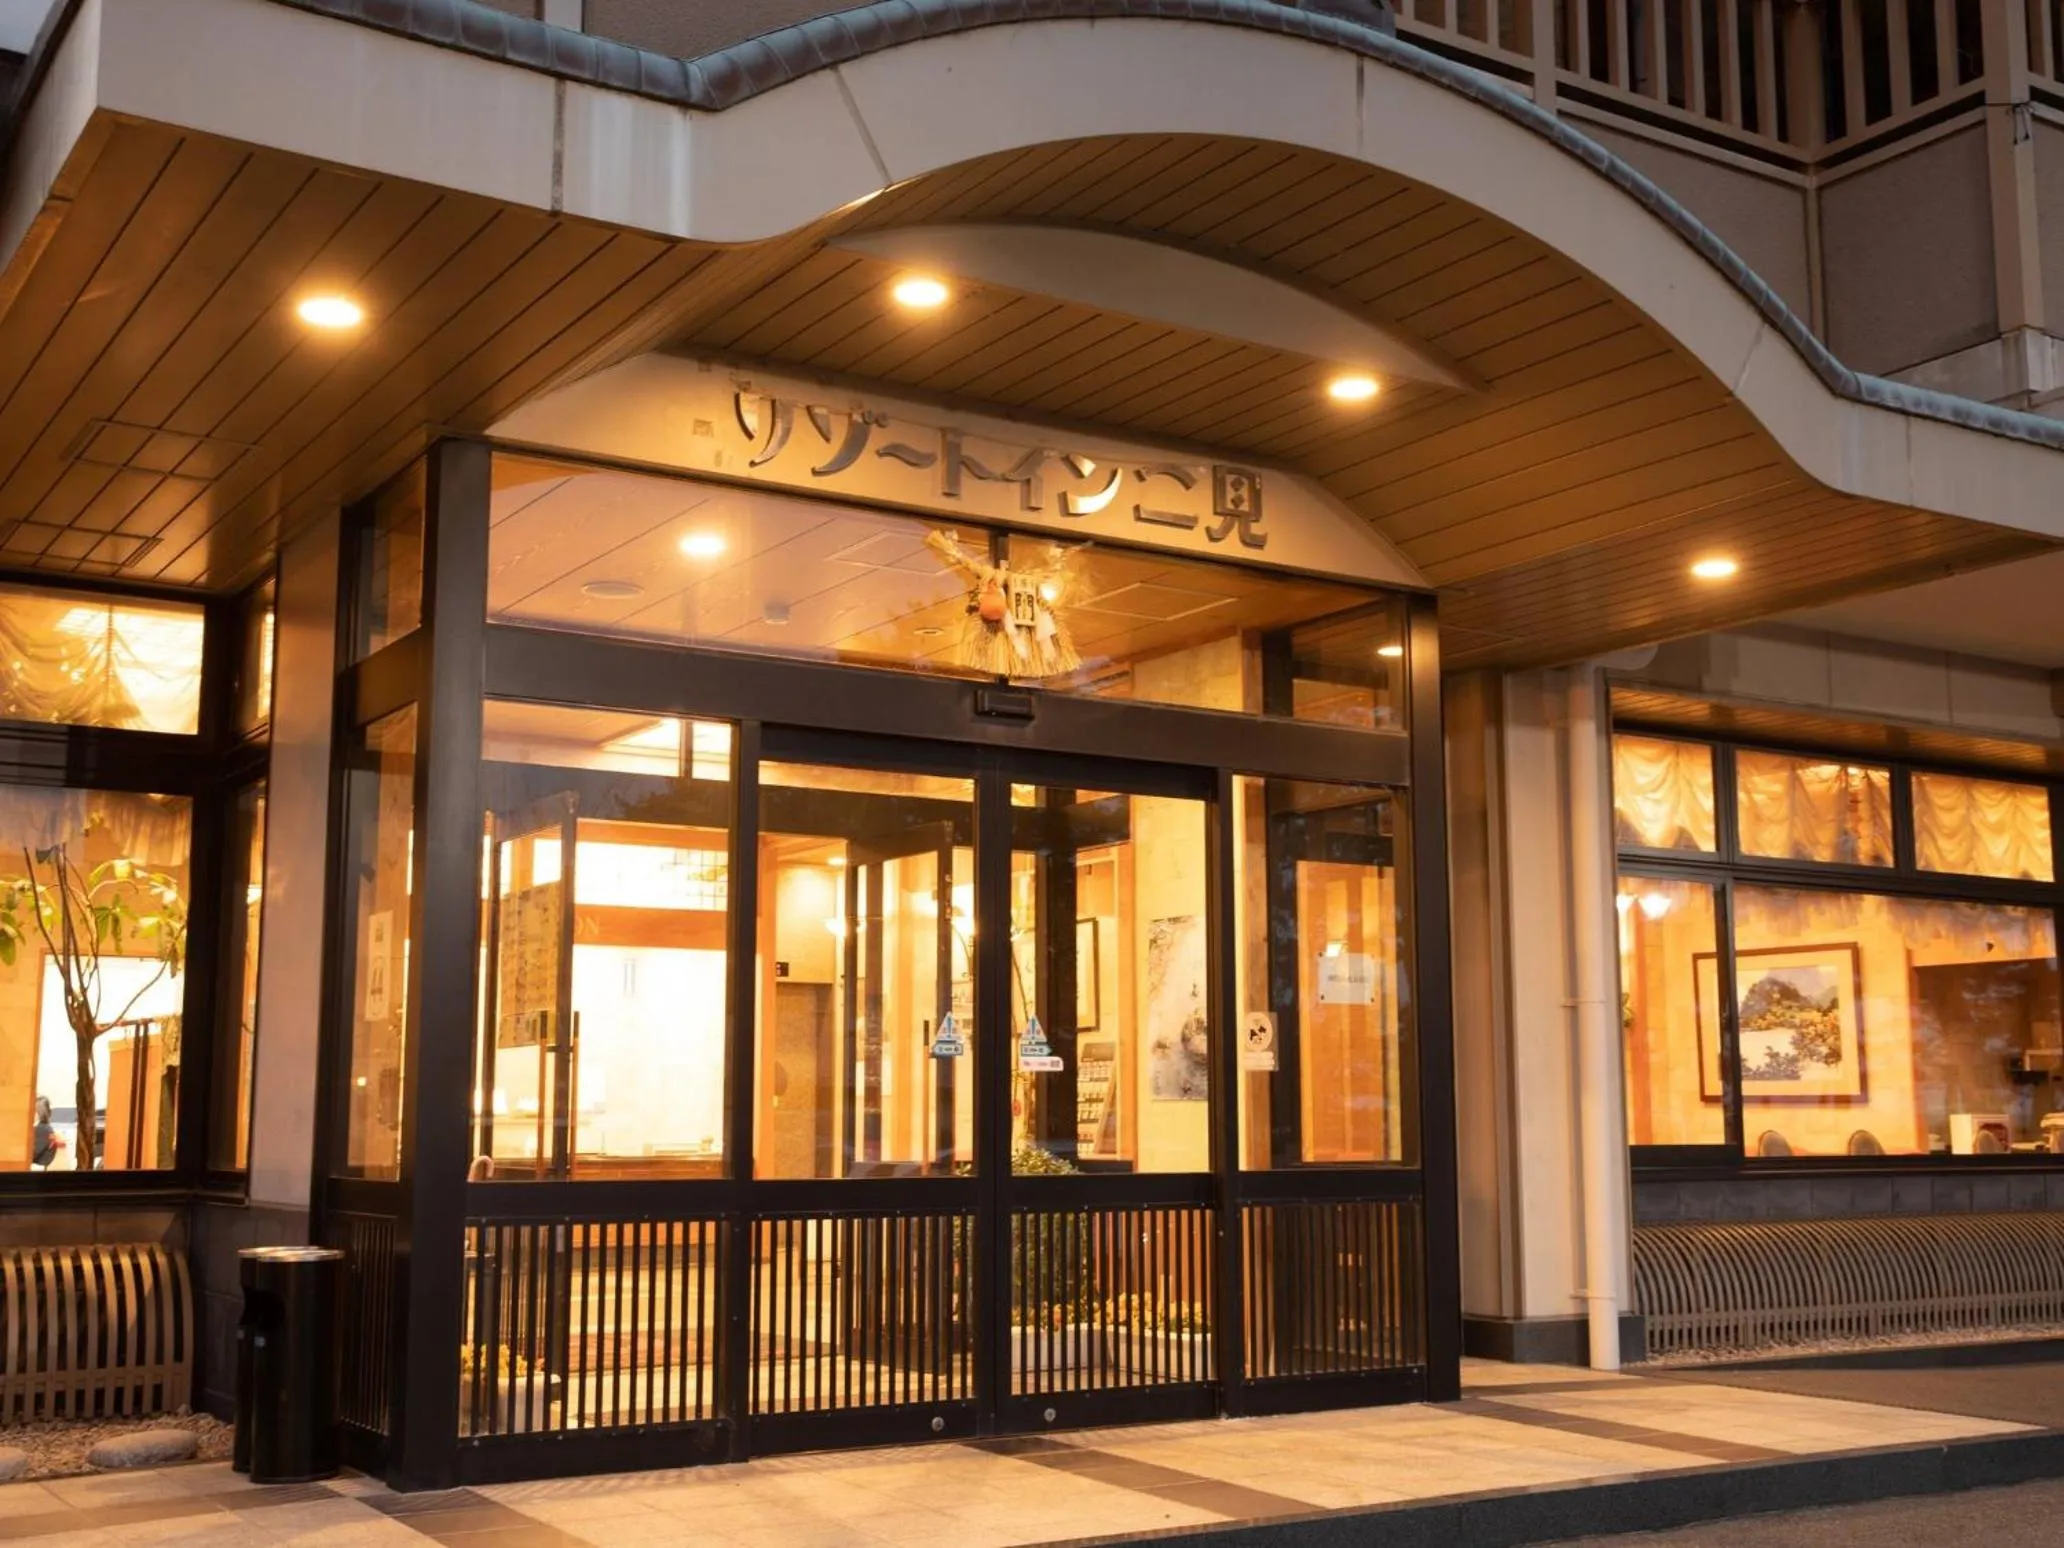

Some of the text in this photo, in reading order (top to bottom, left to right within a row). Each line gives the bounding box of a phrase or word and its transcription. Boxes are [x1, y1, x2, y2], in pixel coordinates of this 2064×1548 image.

[735, 391, 1268, 549] リゾートイン二見
